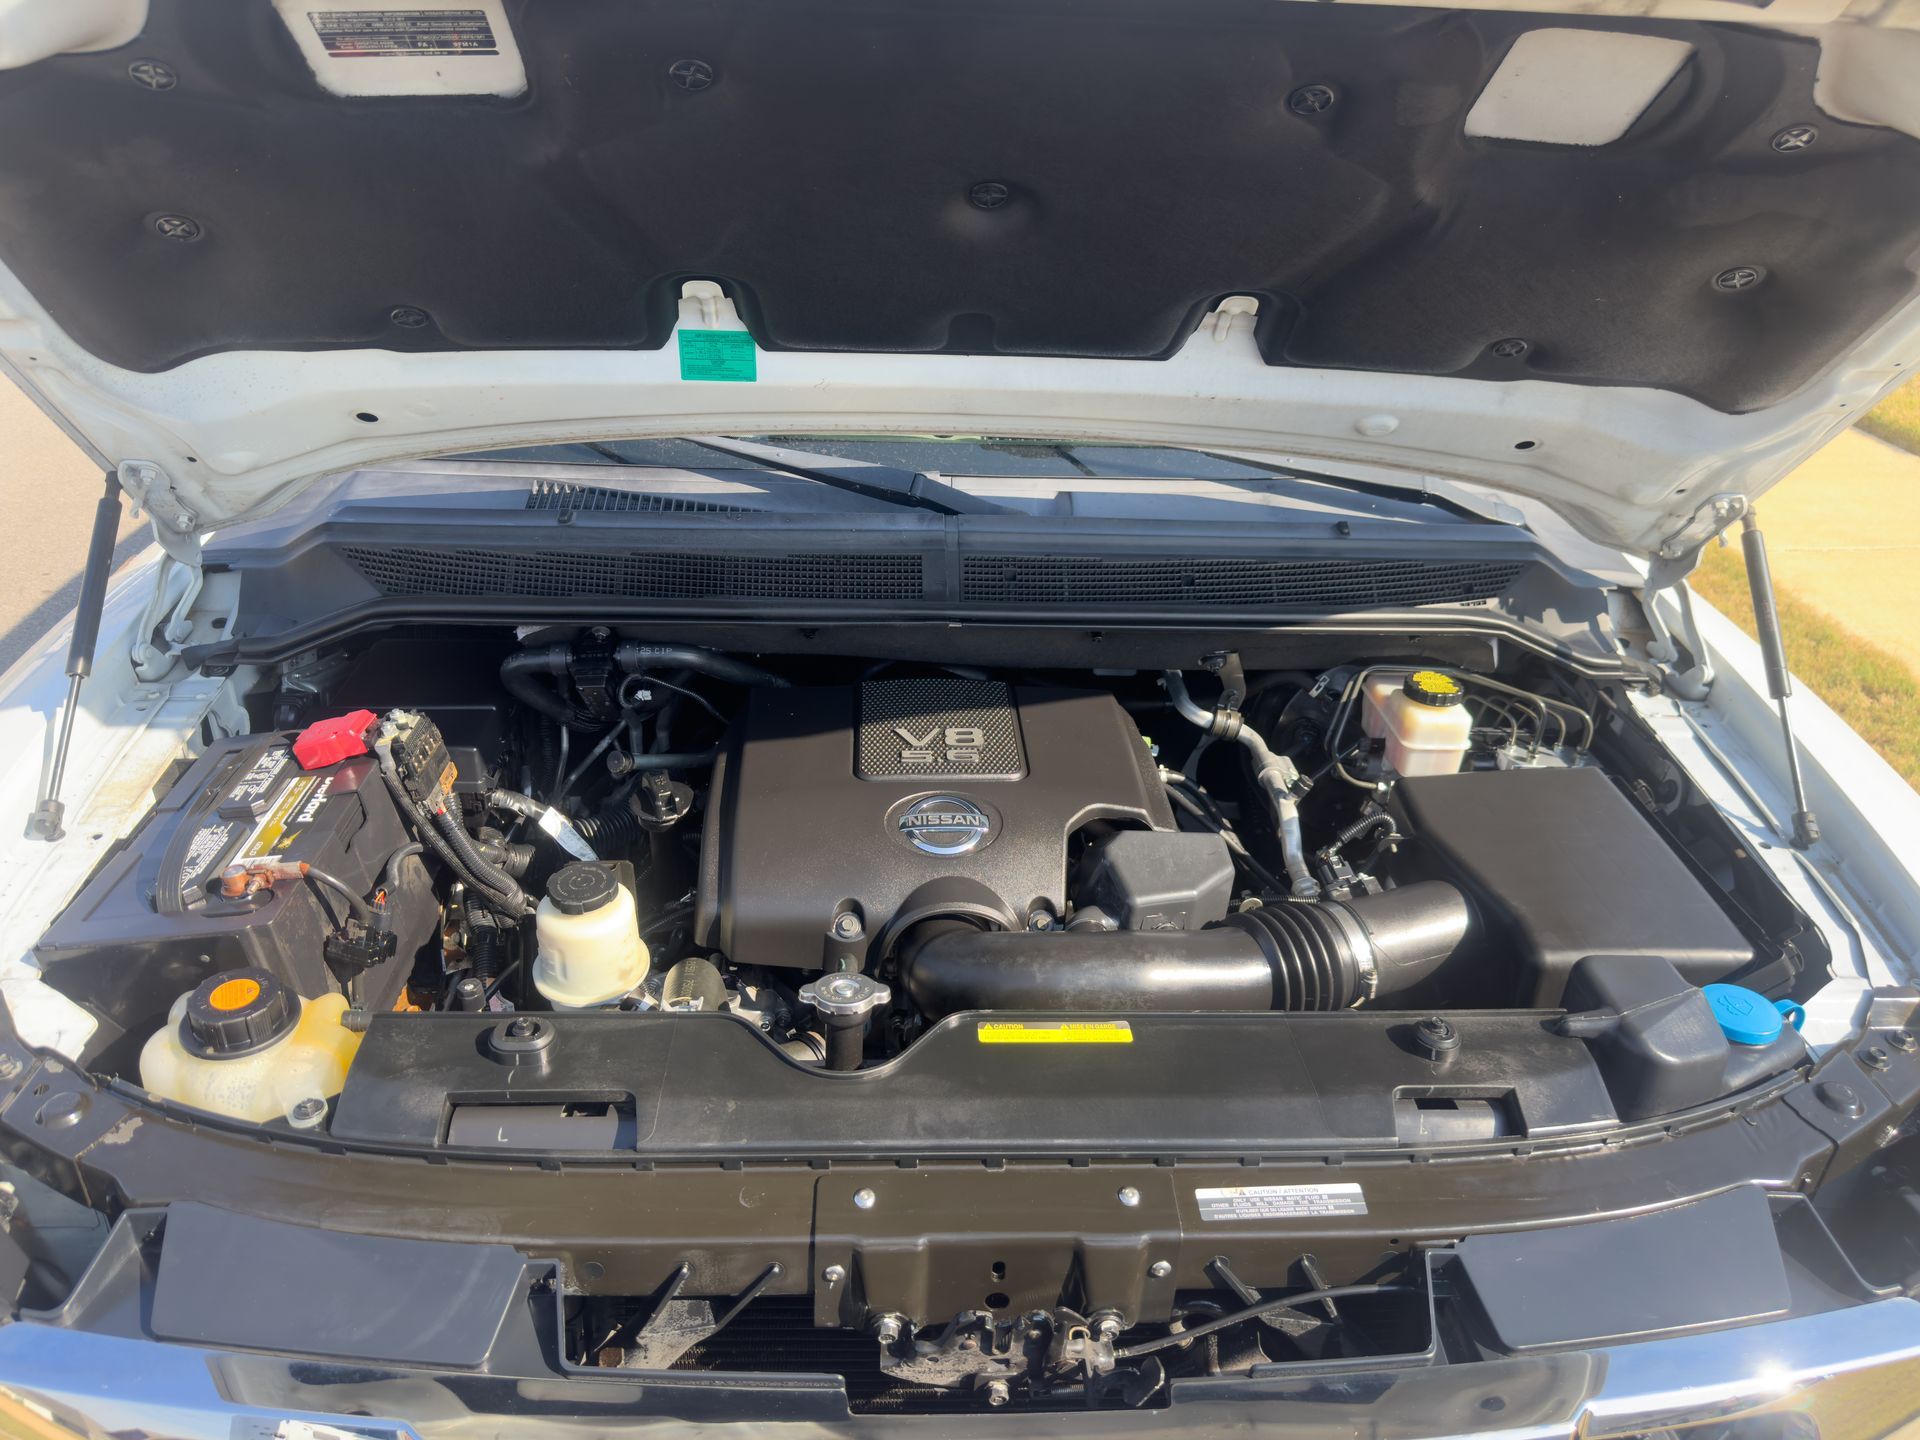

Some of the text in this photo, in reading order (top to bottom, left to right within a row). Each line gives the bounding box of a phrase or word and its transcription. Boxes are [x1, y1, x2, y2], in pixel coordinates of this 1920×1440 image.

[893, 726, 985, 748] V8
[900, 749, 980, 763] 5.6
[907, 815, 980, 826] NISSAN
[1283, 1187, 1319, 1195] ATTENTION
